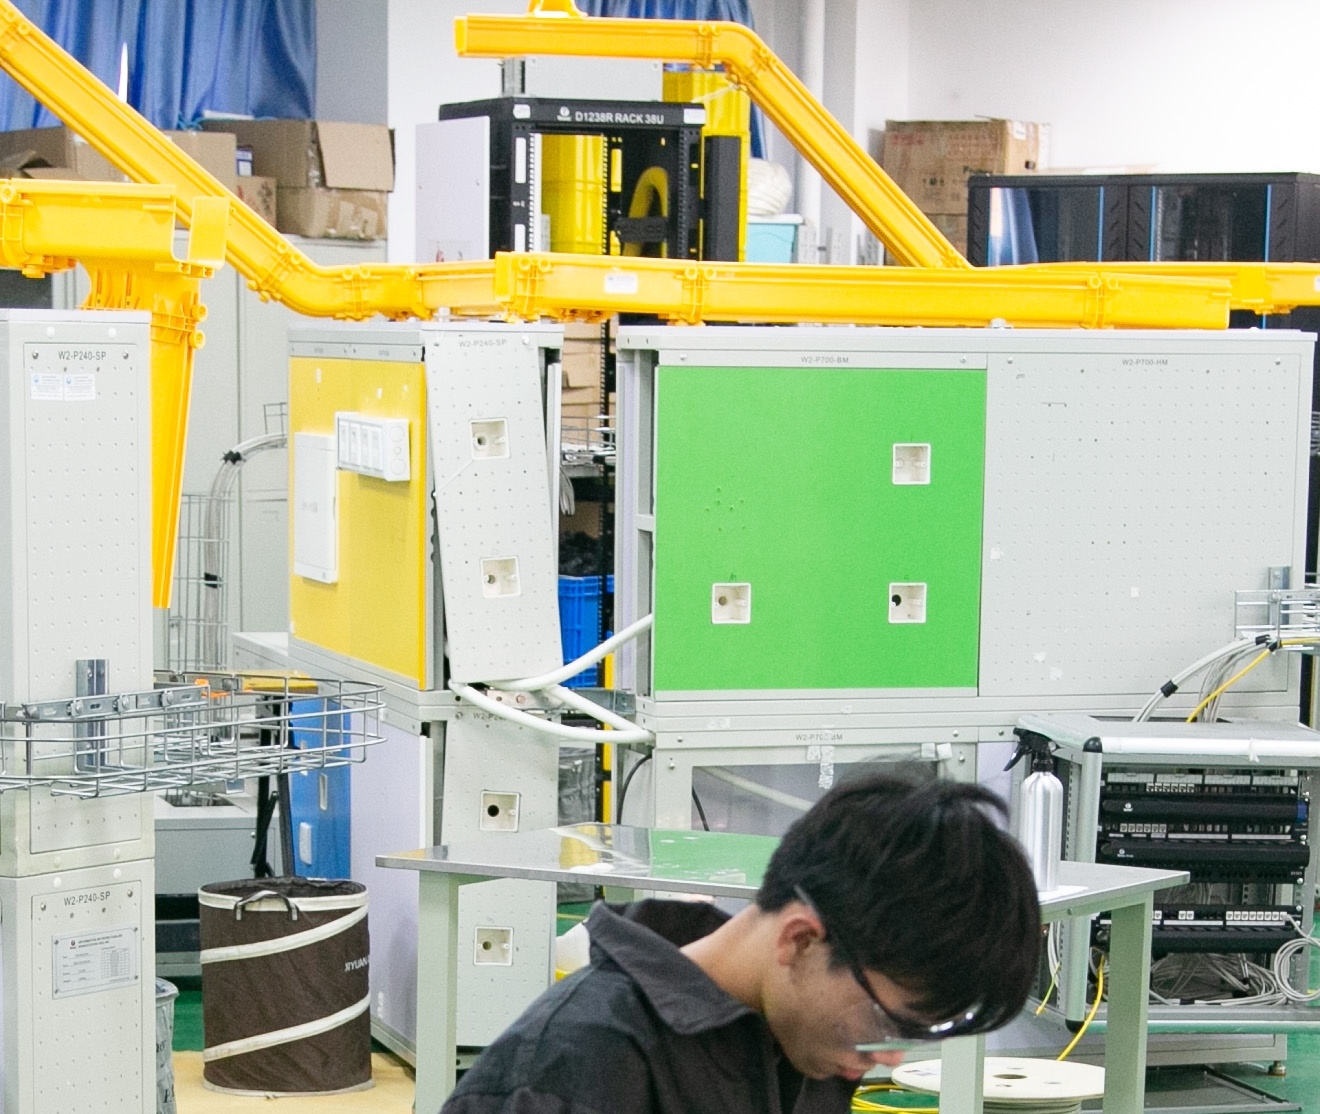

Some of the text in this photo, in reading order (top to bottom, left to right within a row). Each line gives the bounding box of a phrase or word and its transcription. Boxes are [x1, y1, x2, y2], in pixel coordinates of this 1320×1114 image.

[575, 111, 613, 123] D1238R
[615, 112, 643, 124] RACK
[645, 113, 664, 124] 38U
[58, 350, 107, 361] W2-P240-SP
[63, 890, 112, 906] W2-P240-SP
